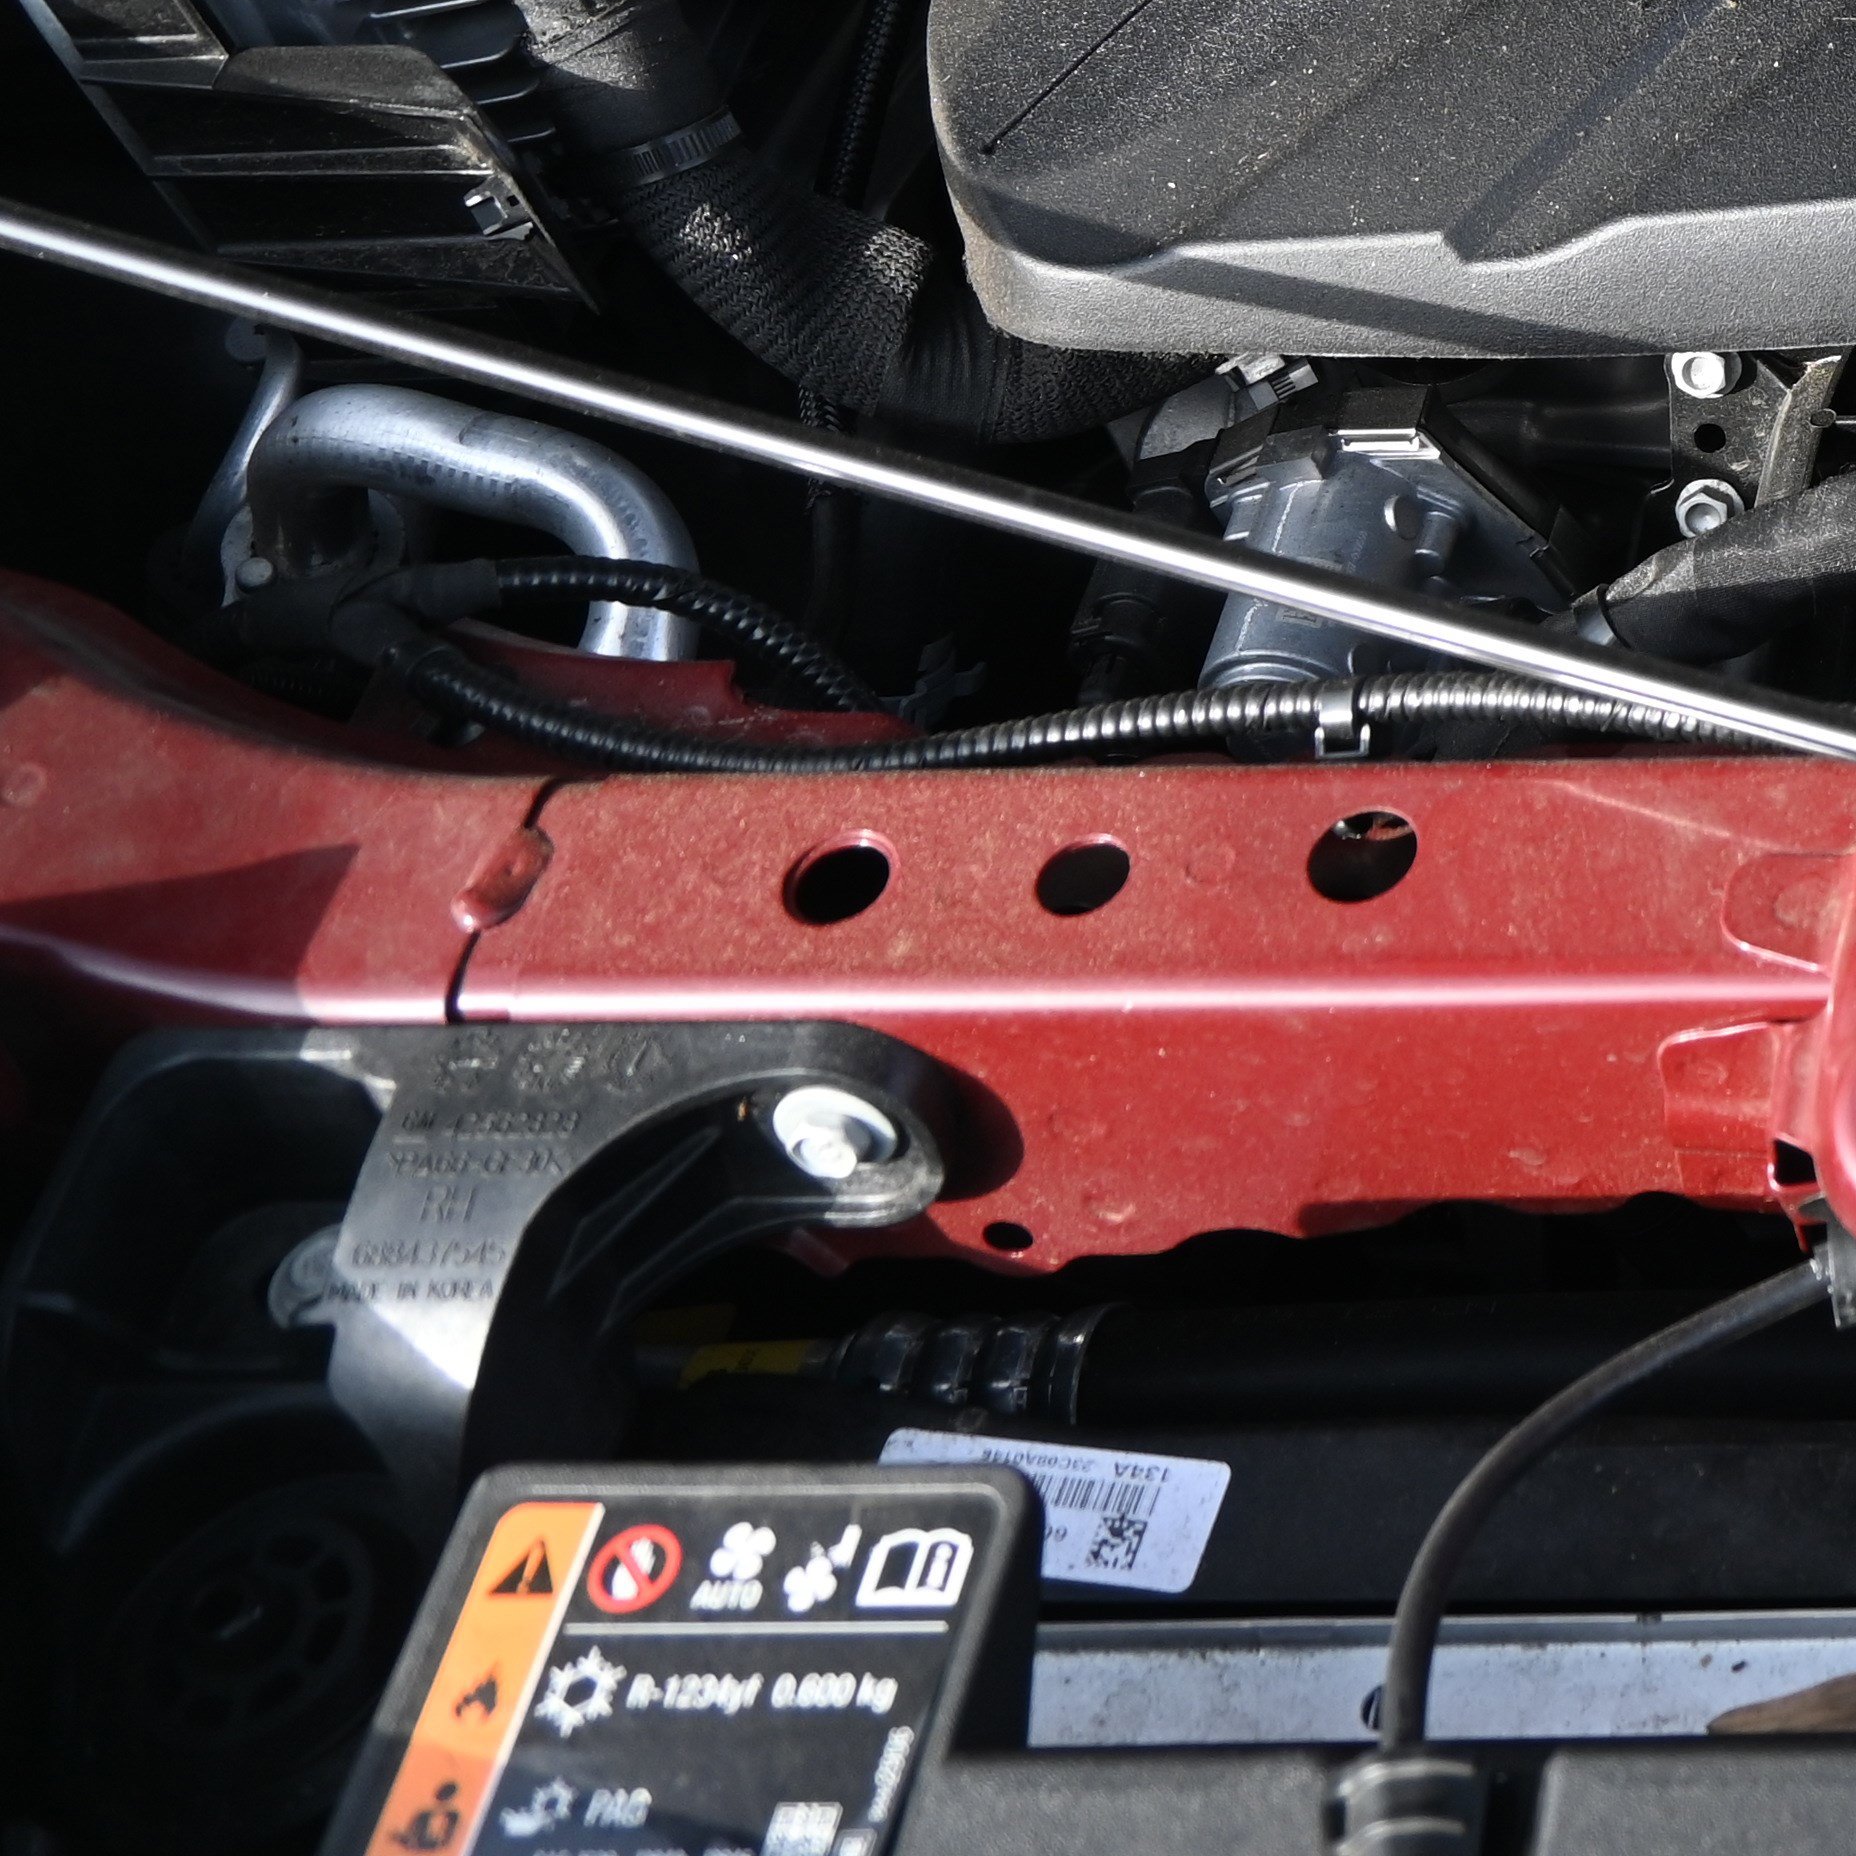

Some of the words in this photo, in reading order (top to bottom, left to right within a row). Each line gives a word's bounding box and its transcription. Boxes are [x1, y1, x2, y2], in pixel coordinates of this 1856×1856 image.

[1113, 1461, 1170, 1483] 134A
[690, 1578, 763, 1611] AUTO
[626, 1672, 764, 1715] R-1234yf
[856, 1671, 898, 1714] kg
[584, 1786, 653, 1828] PAG
